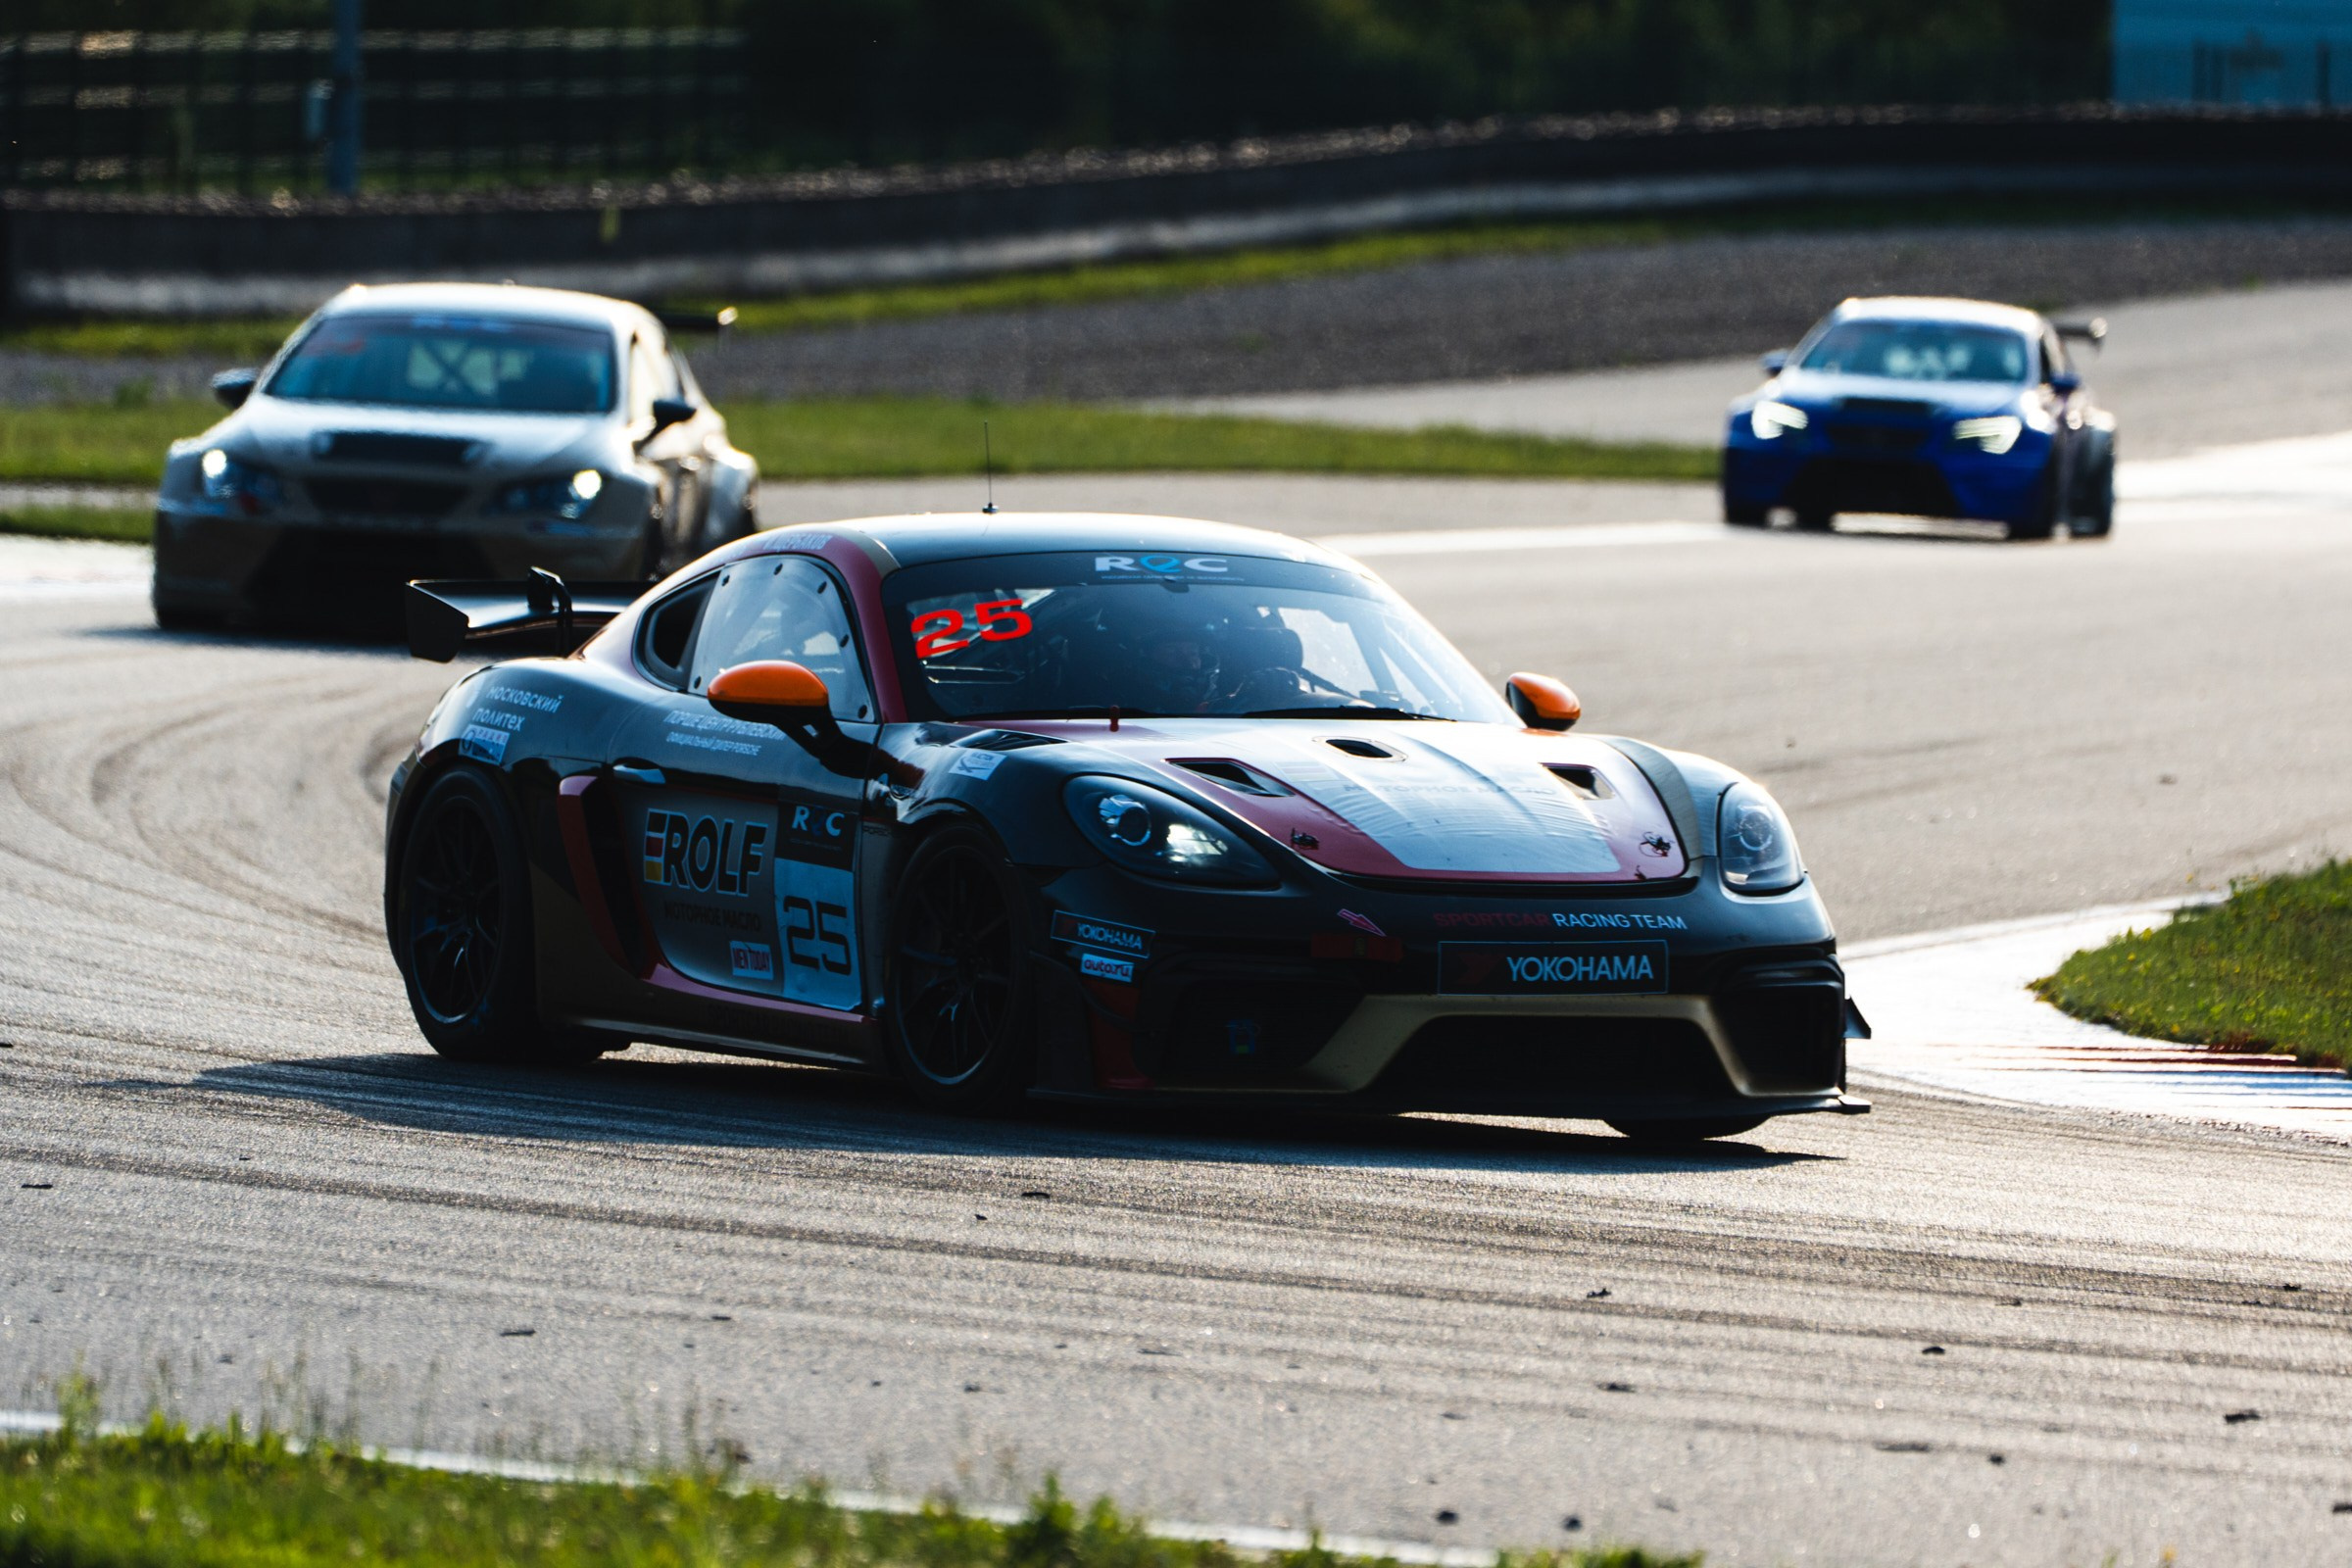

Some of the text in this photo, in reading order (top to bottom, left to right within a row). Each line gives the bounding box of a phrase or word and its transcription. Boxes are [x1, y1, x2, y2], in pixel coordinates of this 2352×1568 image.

[910, 599, 1033, 660] 25
[663, 810, 769, 898] ROLF
[1433, 911, 1688, 929] SPORTCAR RACING TEAM
[783, 896, 852, 975] 25
[1076, 922, 1144, 950] YOKOHAMA
[1084, 957, 1130, 976] auto.ru
[1506, 956, 1654, 981] YOKOHAMA
